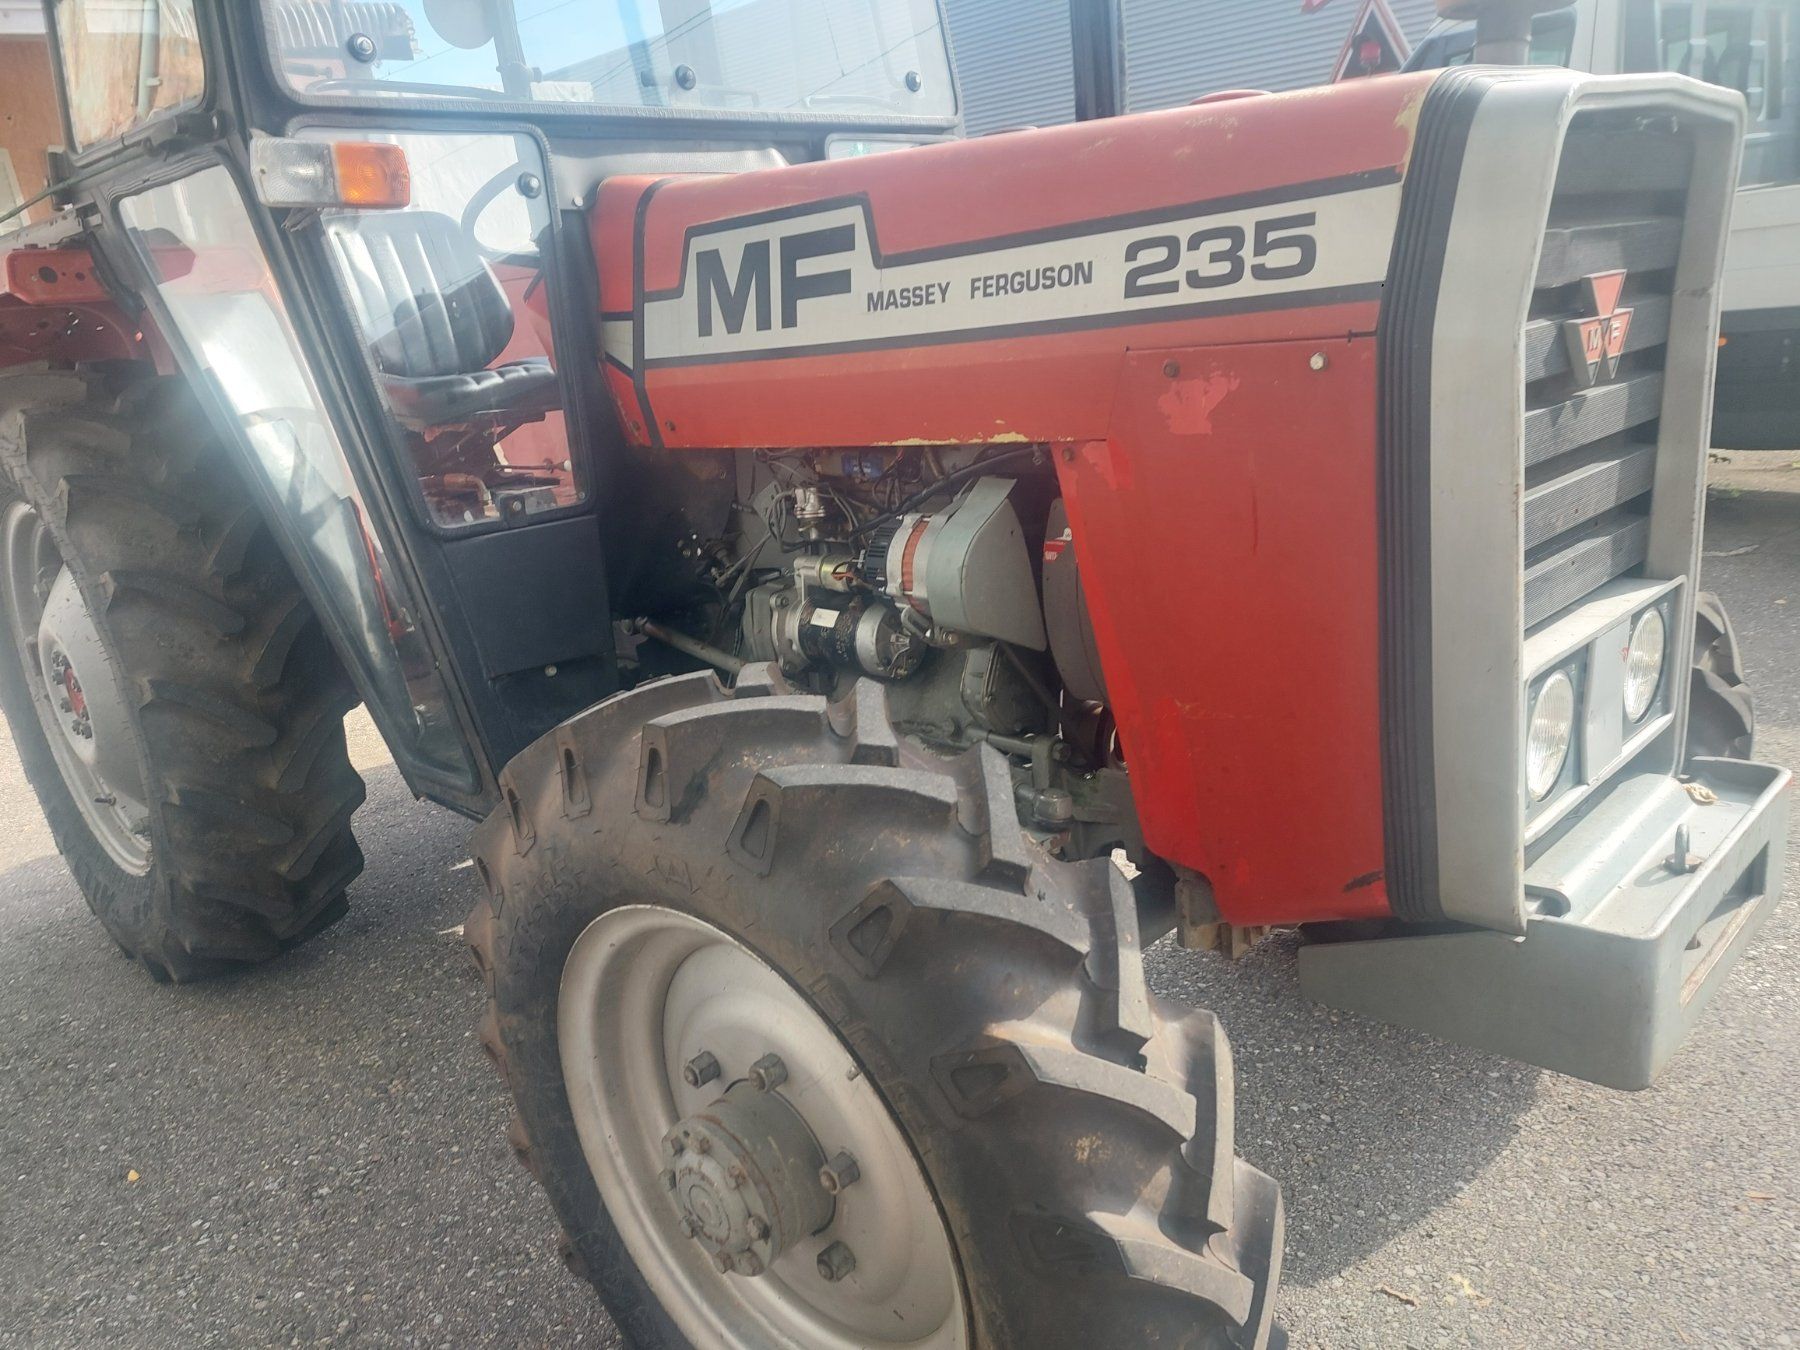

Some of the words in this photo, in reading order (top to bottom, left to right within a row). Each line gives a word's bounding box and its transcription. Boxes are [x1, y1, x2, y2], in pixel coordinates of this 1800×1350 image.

[695, 223, 856, 338] MF
[867, 281, 951, 312] MASSEY
[970, 261, 1093, 299] FERGUSON
[1123, 211, 1317, 299] 235
[1587, 320, 1622, 352] MF
